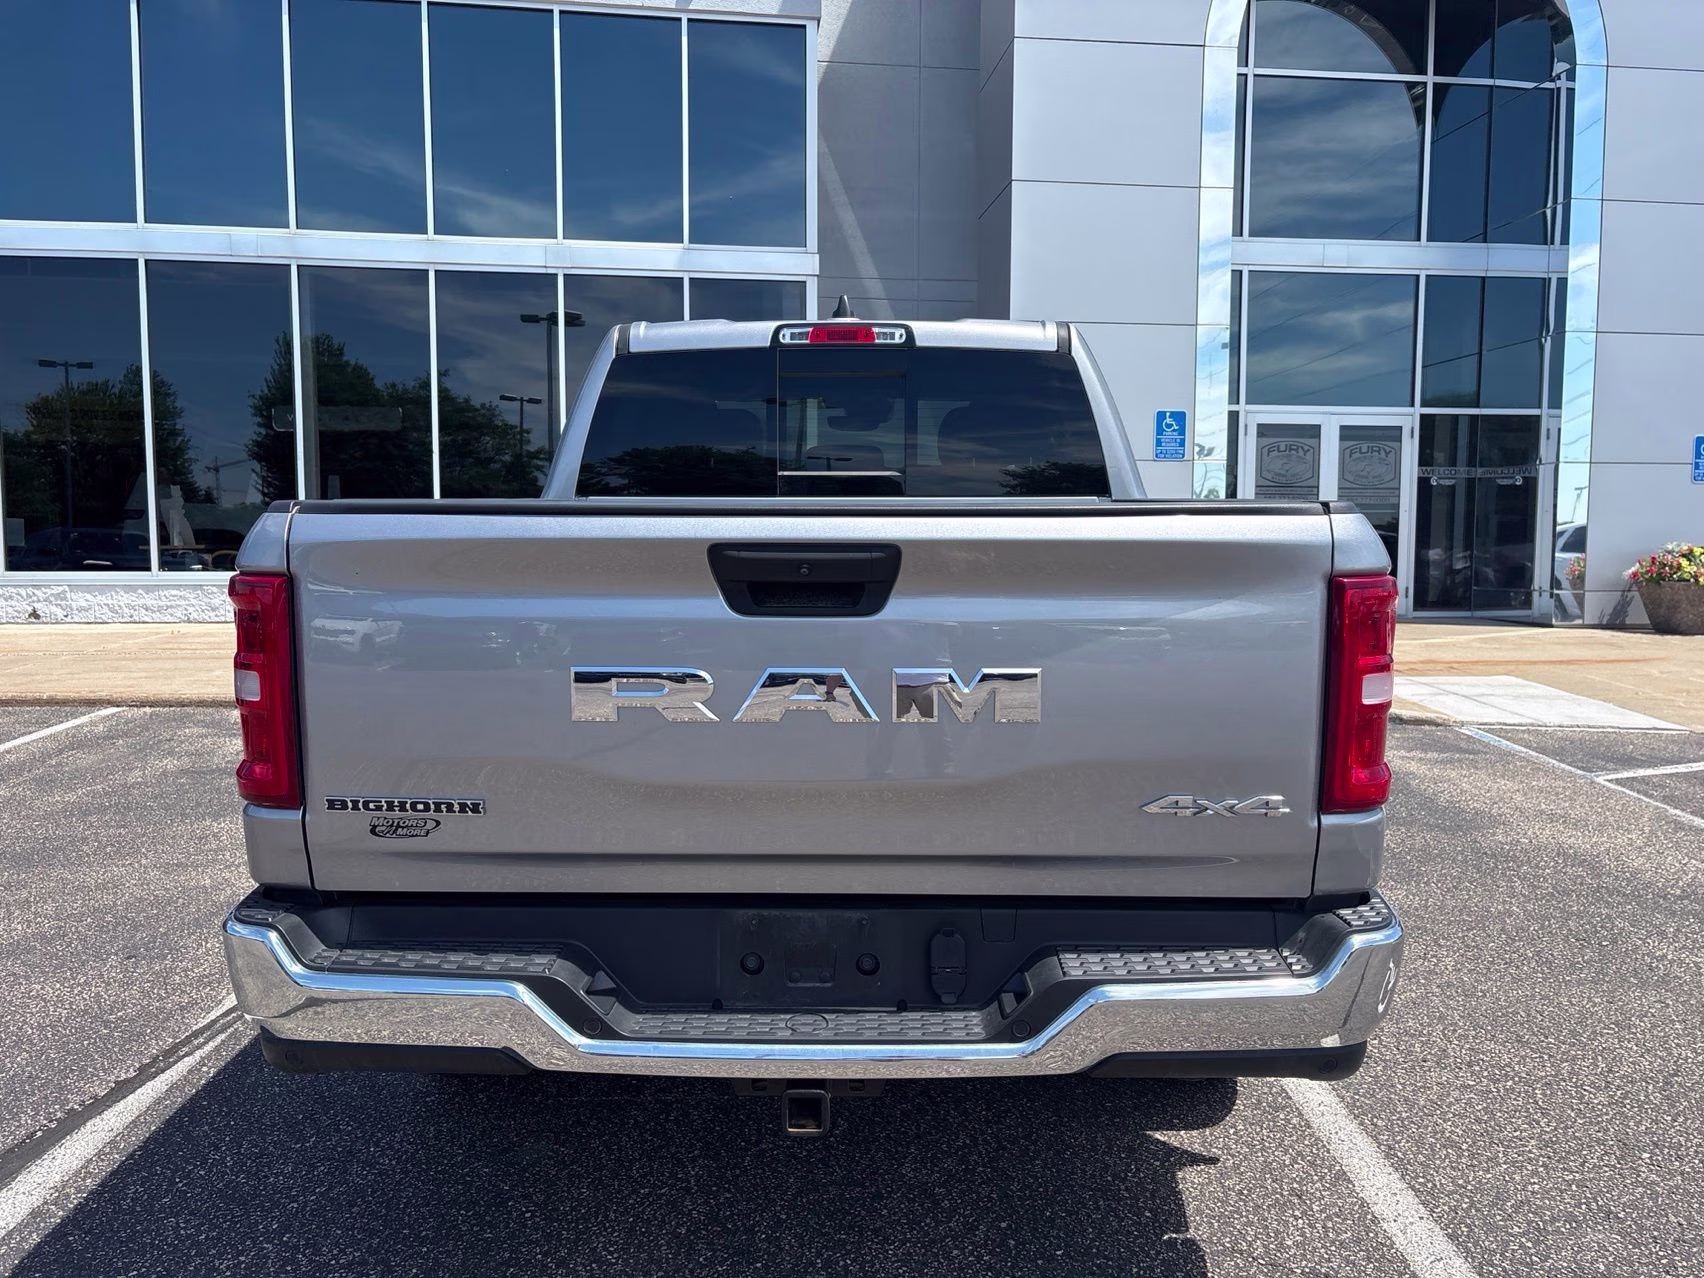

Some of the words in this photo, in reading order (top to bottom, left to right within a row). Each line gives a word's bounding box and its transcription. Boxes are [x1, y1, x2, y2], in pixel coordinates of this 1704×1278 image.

[1266, 444, 1310, 457] FURY
[1349, 445, 1392, 458] FURY
[1421, 468, 1474, 476] WELCOME
[570, 666, 1043, 723] RAM
[325, 797, 485, 815] BIGHORN
[370, 817, 426, 826] MOTORS
[397, 828, 428, 836] MORE
